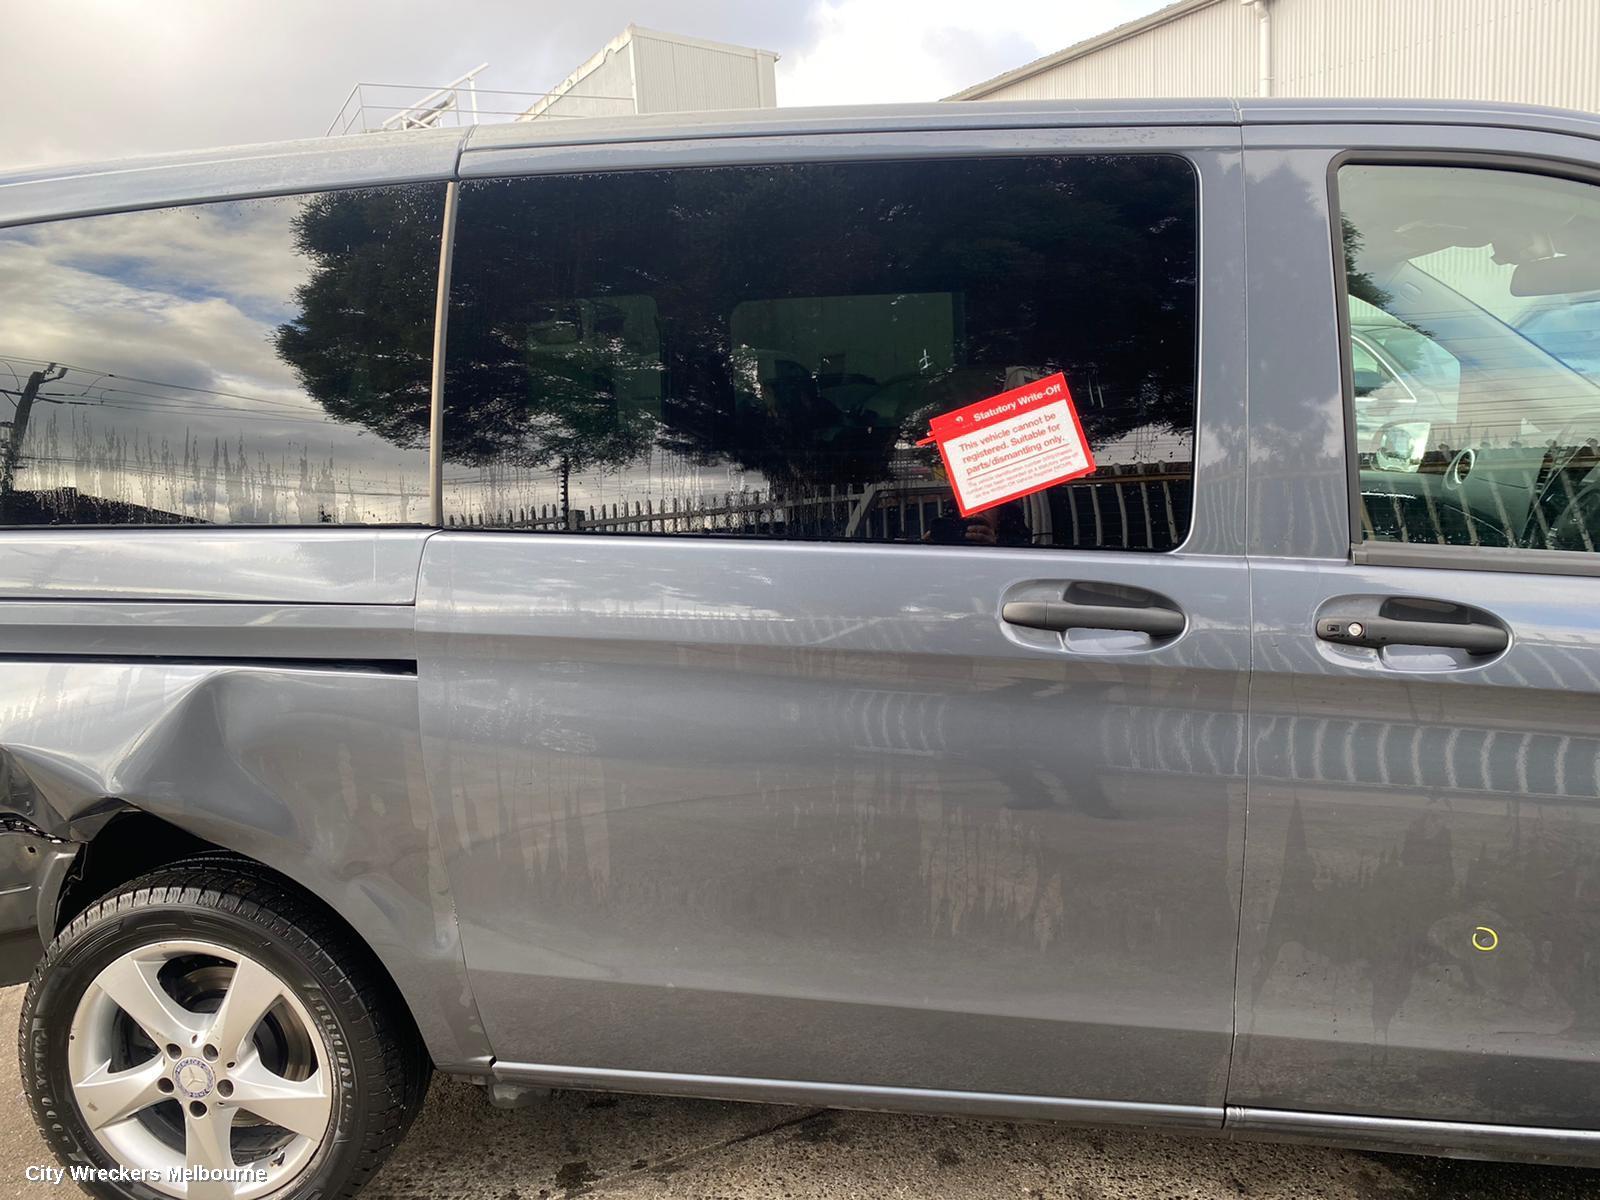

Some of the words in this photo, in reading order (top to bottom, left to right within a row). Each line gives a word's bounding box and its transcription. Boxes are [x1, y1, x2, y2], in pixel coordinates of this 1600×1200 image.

[973, 401, 1017, 422] Statutory
[1017, 383, 1061, 406] Write-Off
[958, 440, 979, 452] This
[979, 429, 1011, 445] vehicle
[1012, 416, 1044, 434] cannot
[1043, 413, 1057, 422] be
[962, 441, 1010, 464] registered.
[1010, 428, 1047, 447] Suitable
[1047, 423, 1061, 433] for
[966, 442, 1043, 476] parts/dismantling
[1043, 435, 1065, 447] only.
